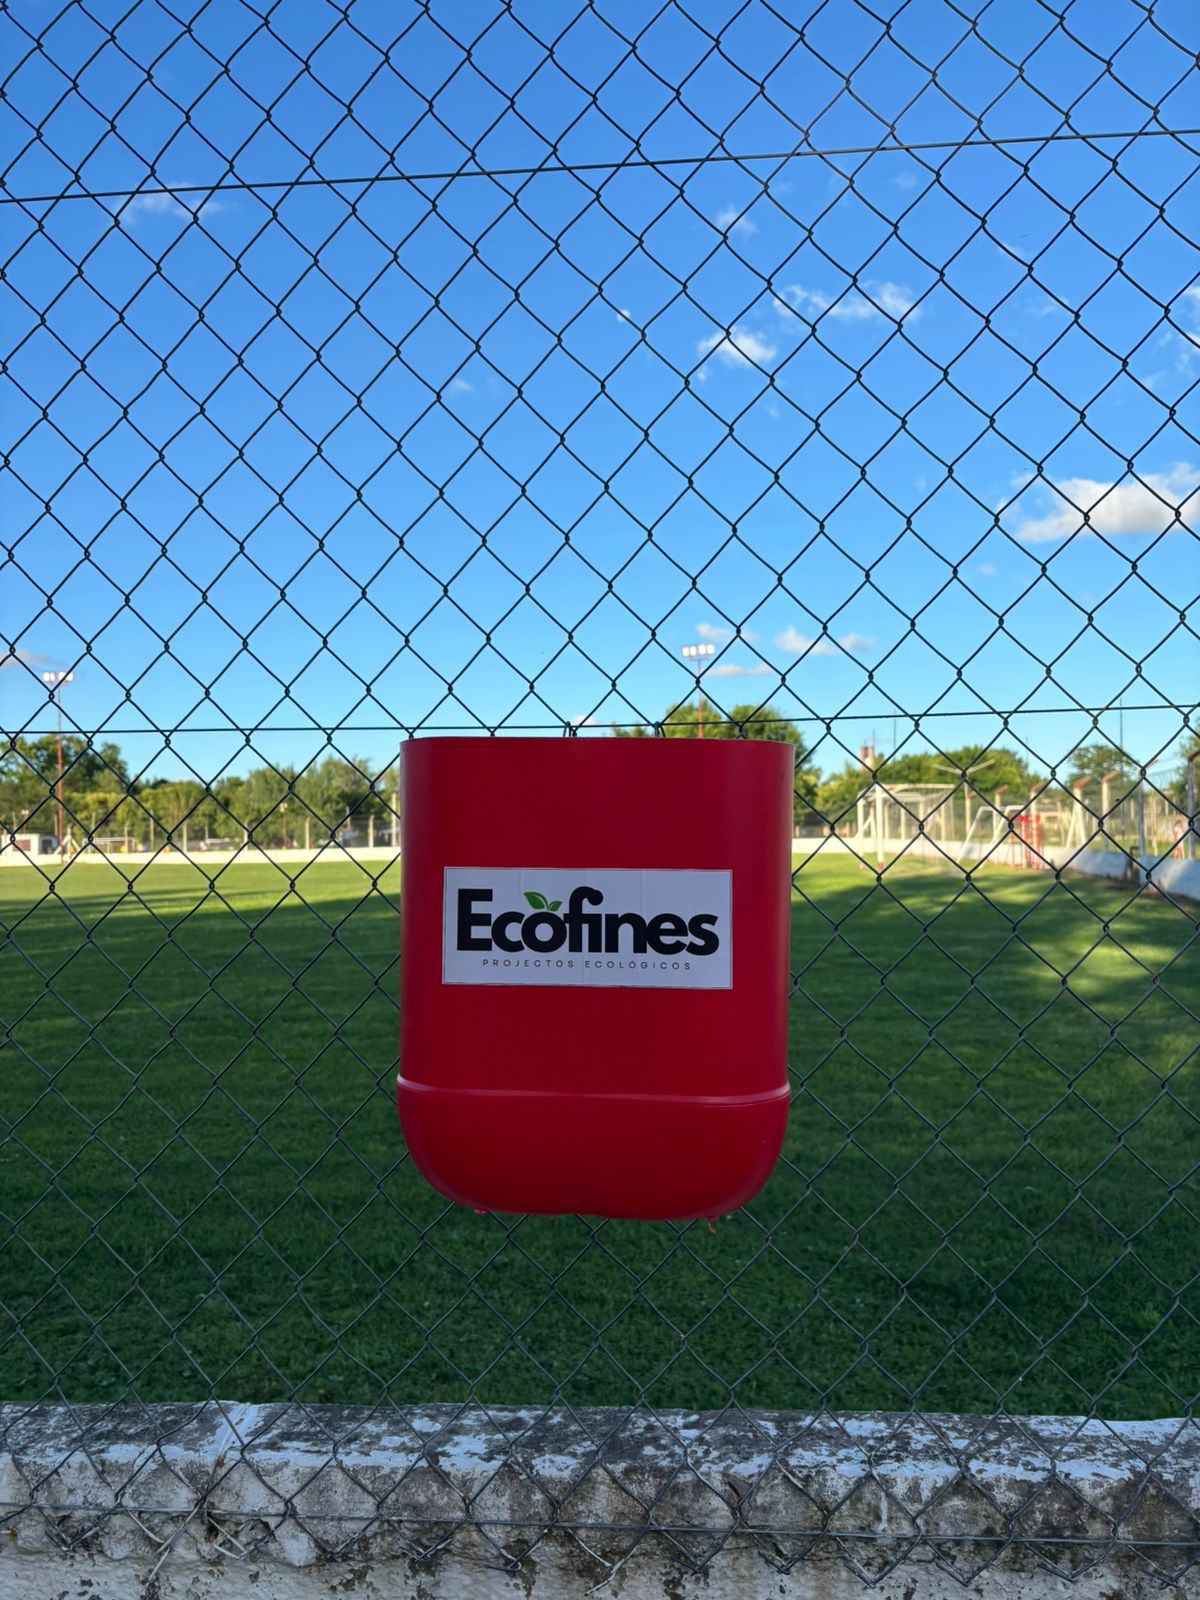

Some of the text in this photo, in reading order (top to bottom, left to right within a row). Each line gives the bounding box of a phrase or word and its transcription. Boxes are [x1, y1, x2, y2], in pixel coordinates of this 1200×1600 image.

[457, 886, 720, 956] Ecofines
[482, 959, 690, 970] PROJECTOS ECOLÓGICOS
